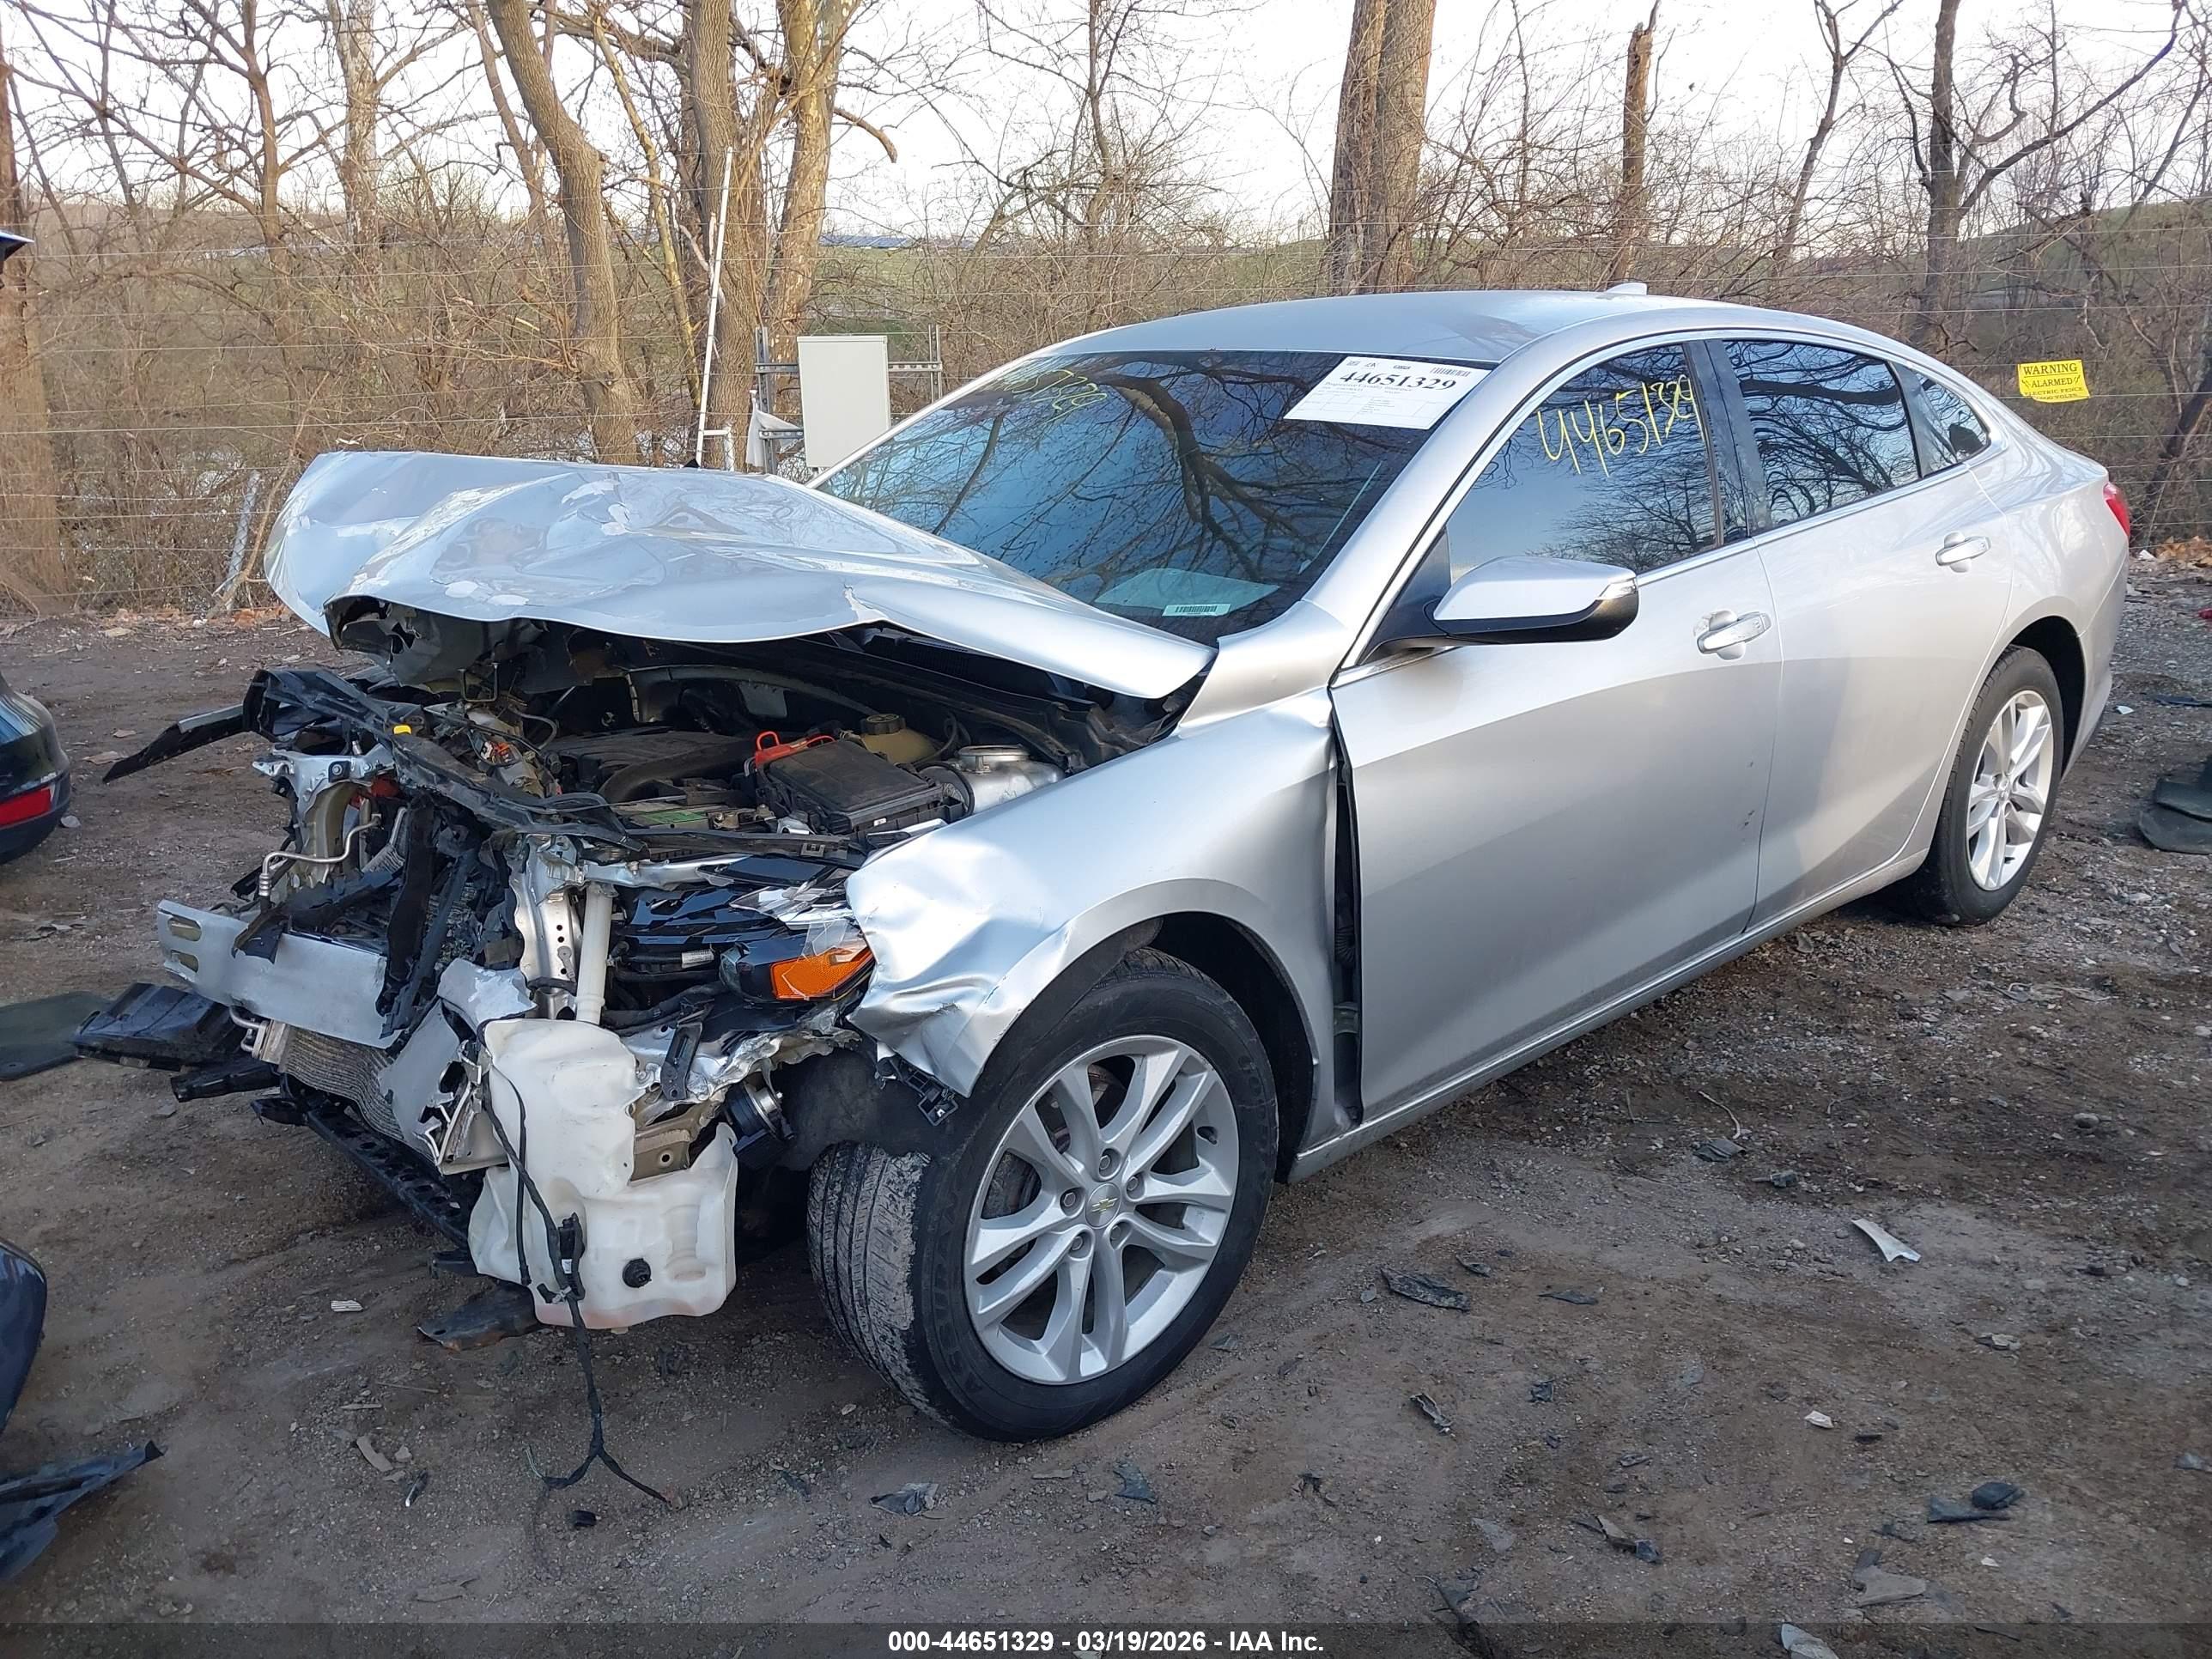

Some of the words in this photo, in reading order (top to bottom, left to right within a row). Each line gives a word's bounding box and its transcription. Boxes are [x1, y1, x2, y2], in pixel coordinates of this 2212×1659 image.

[2023, 363, 2077, 375] WARNING
[1340, 371, 1457, 391] 44651329
[2031, 378, 2073, 388] ALARMED
